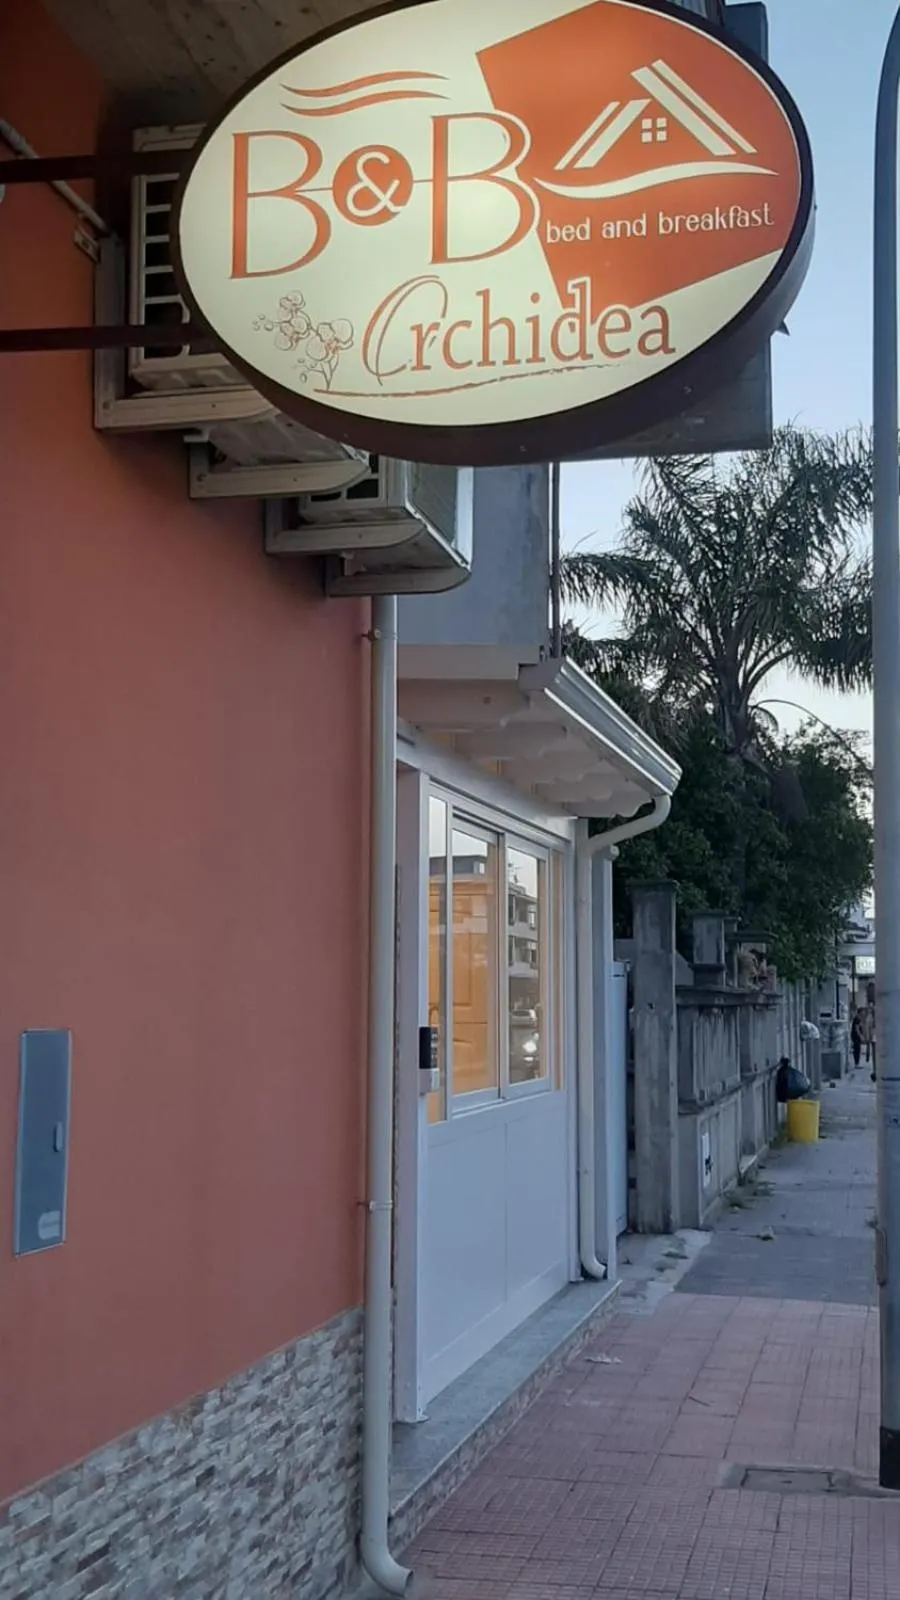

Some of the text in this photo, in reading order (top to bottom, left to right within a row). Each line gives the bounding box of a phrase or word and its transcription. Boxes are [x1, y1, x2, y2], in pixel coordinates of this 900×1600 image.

[230, 111, 540, 279] B&B
[546, 202, 774, 243] bed and breakfast
[362, 275, 676, 386] Orchidea
